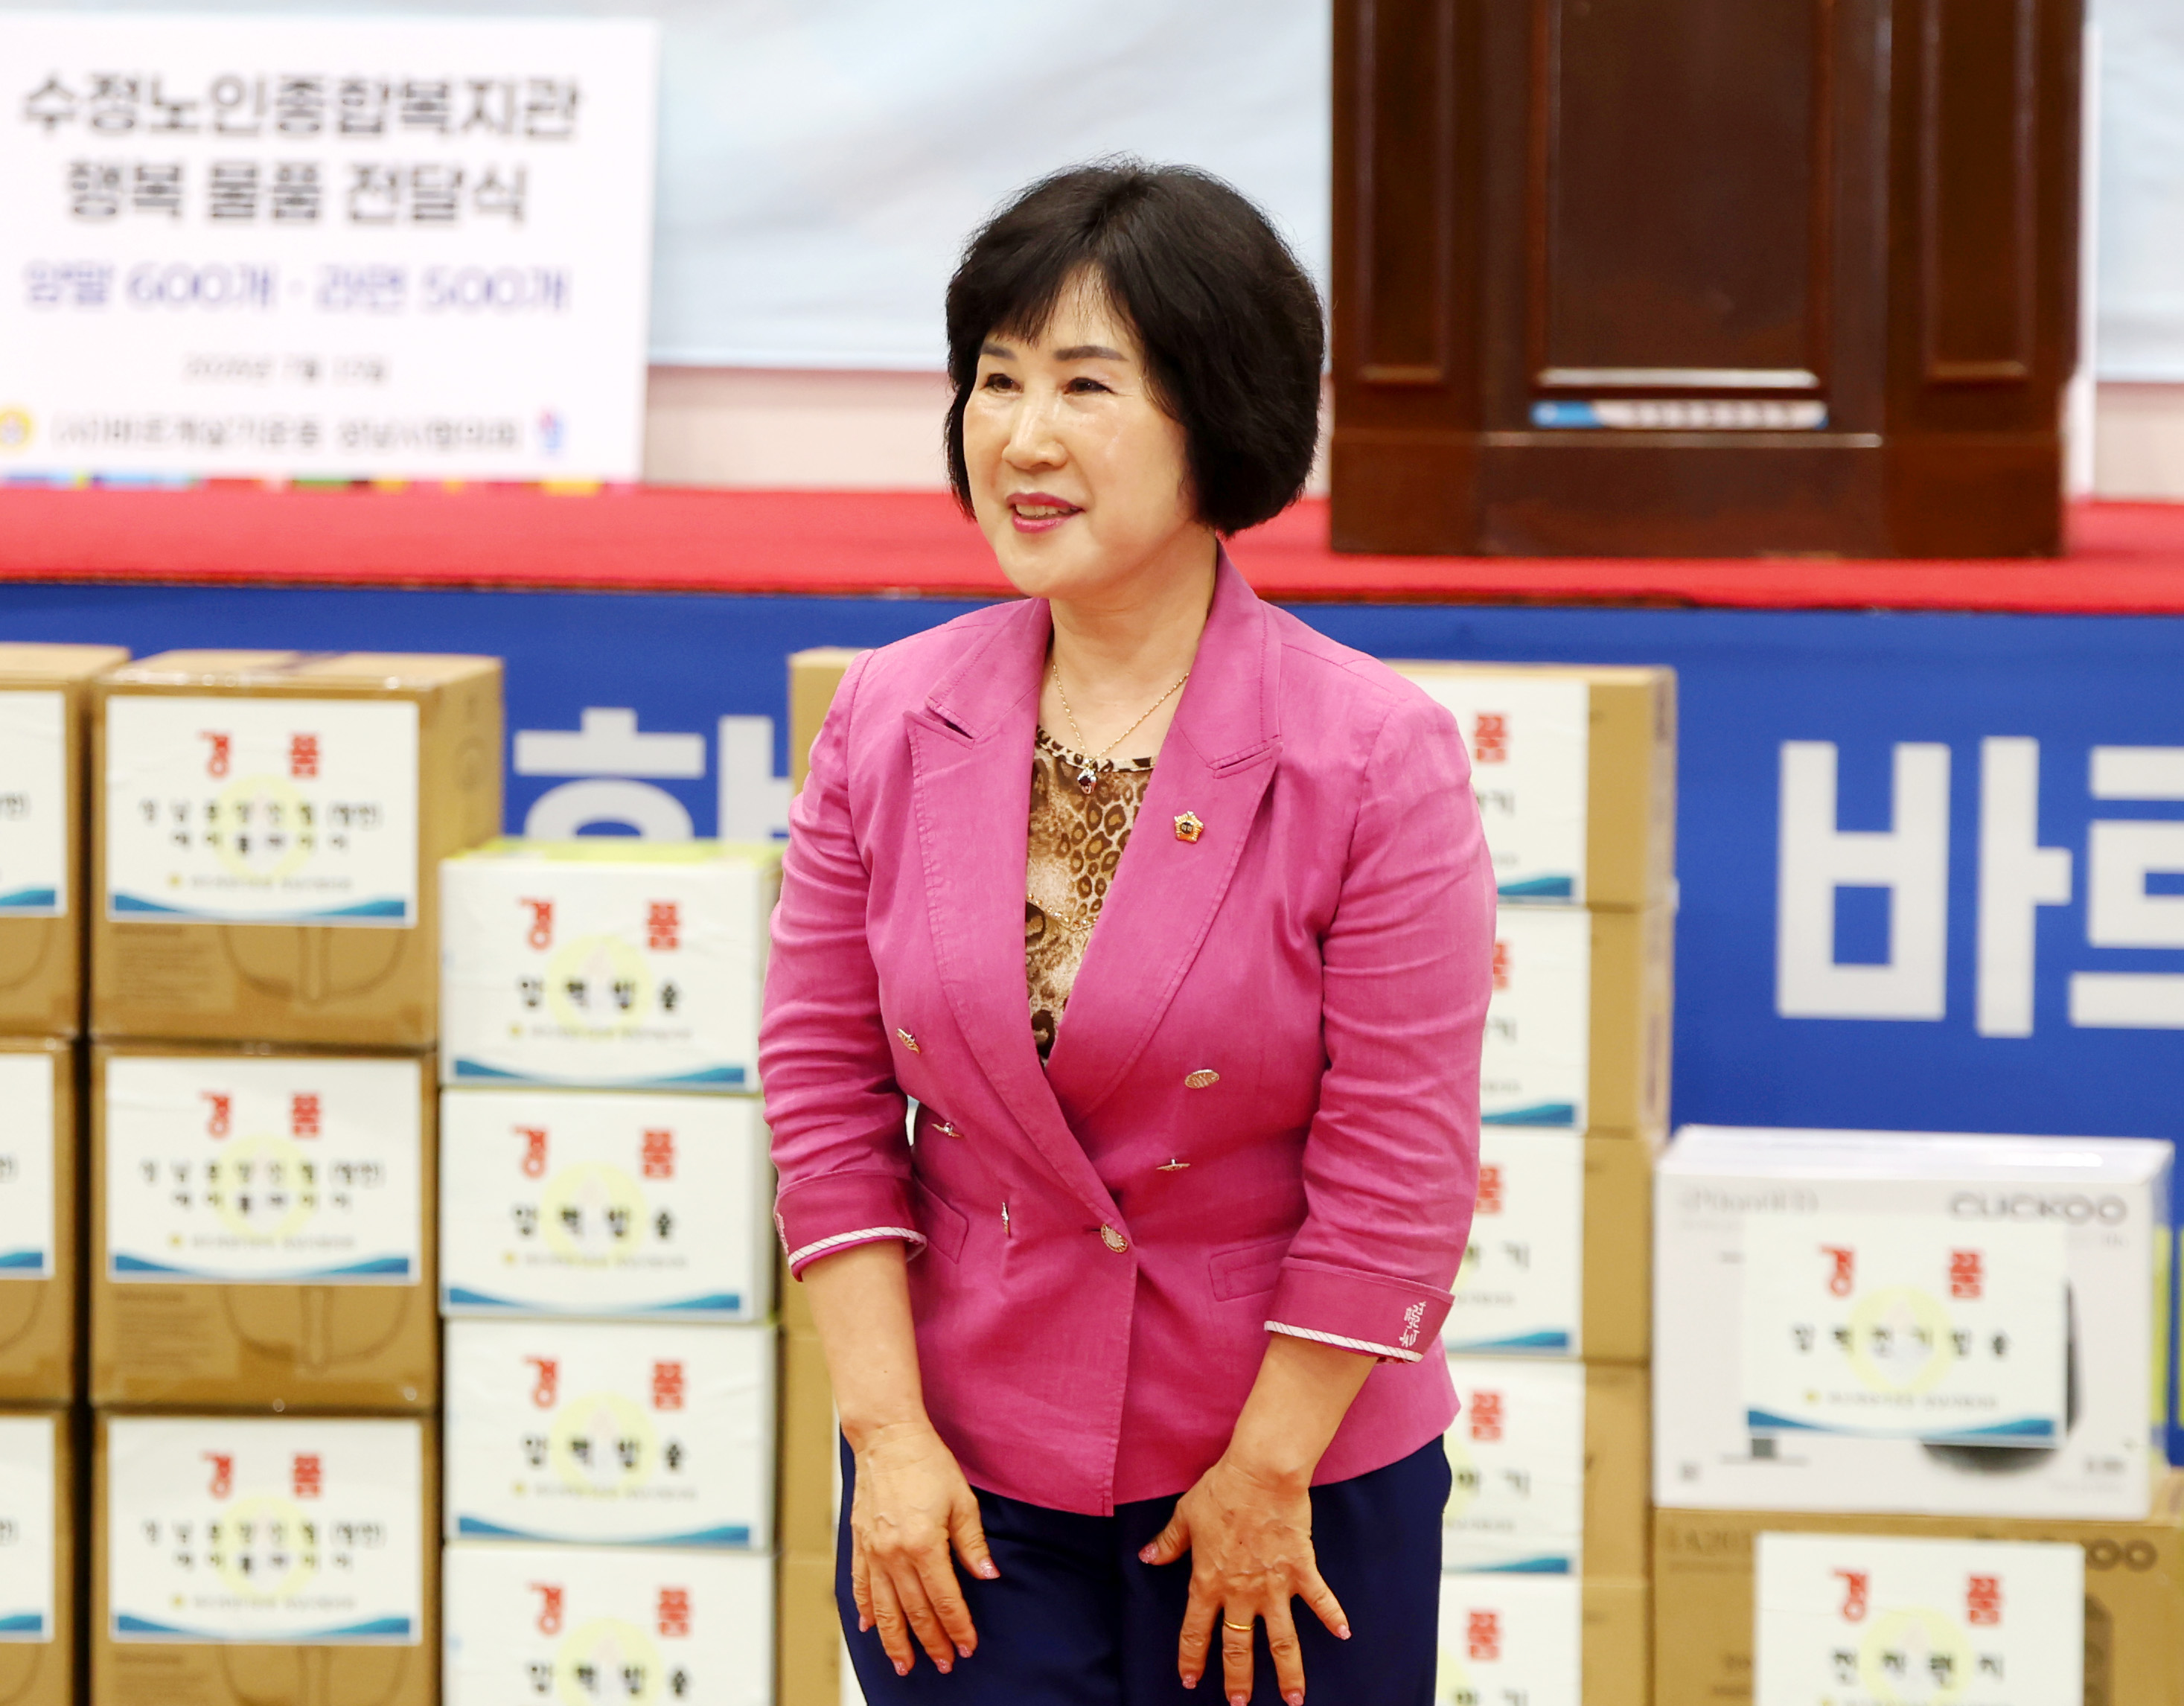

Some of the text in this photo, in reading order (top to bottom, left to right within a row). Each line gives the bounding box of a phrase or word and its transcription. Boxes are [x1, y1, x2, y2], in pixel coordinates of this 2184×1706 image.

[25, 74, 581, 140] 수정노인종합복지관
[69, 161, 526, 225] 행복 물품 전달식
[126, 265, 275, 307] 600개
[423, 267, 569, 311] 500개
[1948, 1193, 2127, 1224] CUCKOO
